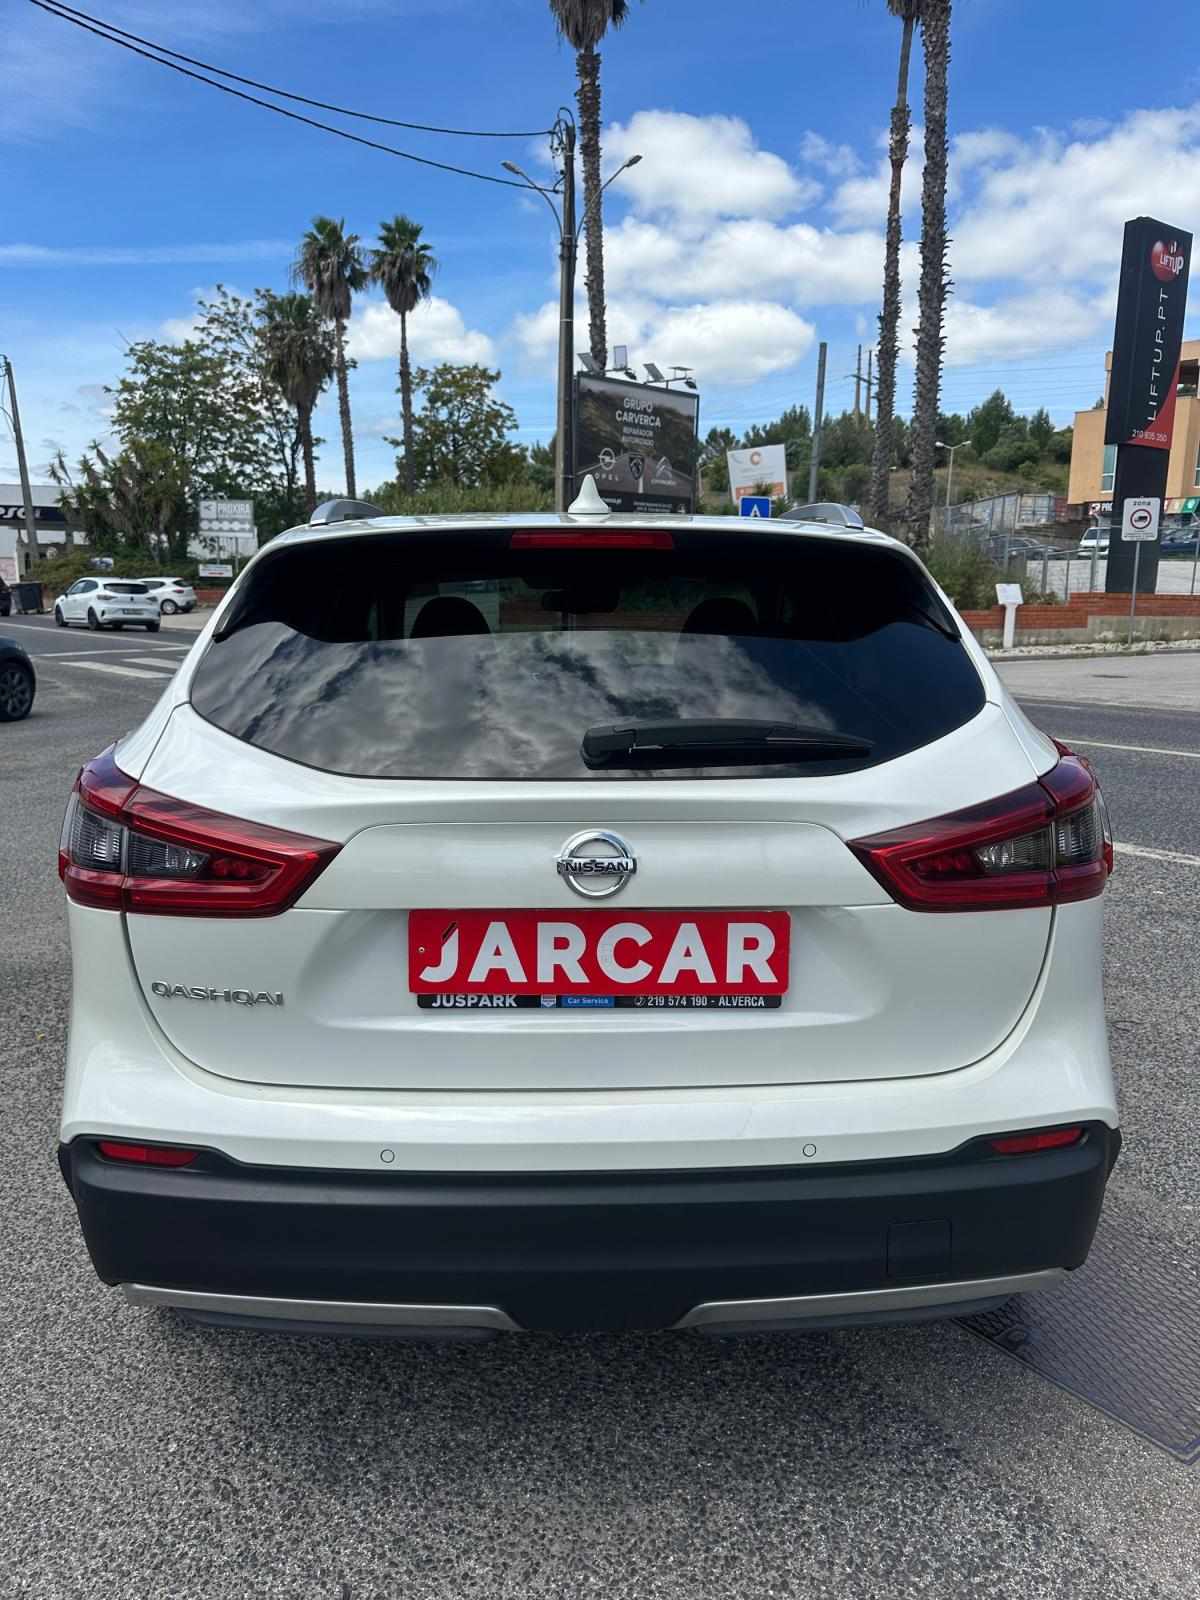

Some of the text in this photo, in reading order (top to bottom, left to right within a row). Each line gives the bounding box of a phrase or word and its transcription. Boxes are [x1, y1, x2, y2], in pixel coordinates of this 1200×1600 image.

[623, 398, 653, 413] GRUPO
[615, 410, 662, 427] CARVERCA
[594, 472, 619, 481] OPEL
[565, 861, 629, 873] NISSAN
[418, 921, 778, 984] JARCAR
[151, 979, 285, 1007] QASHQAI
[431, 994, 518, 1008] JUSPARK
[567, 997, 609, 1005] Car Service
[647, 996, 665, 1007] 219
[668, 996, 687, 1007] 574
[691, 996, 708, 1007] 190
[718, 996, 765, 1007] ALVERCA
